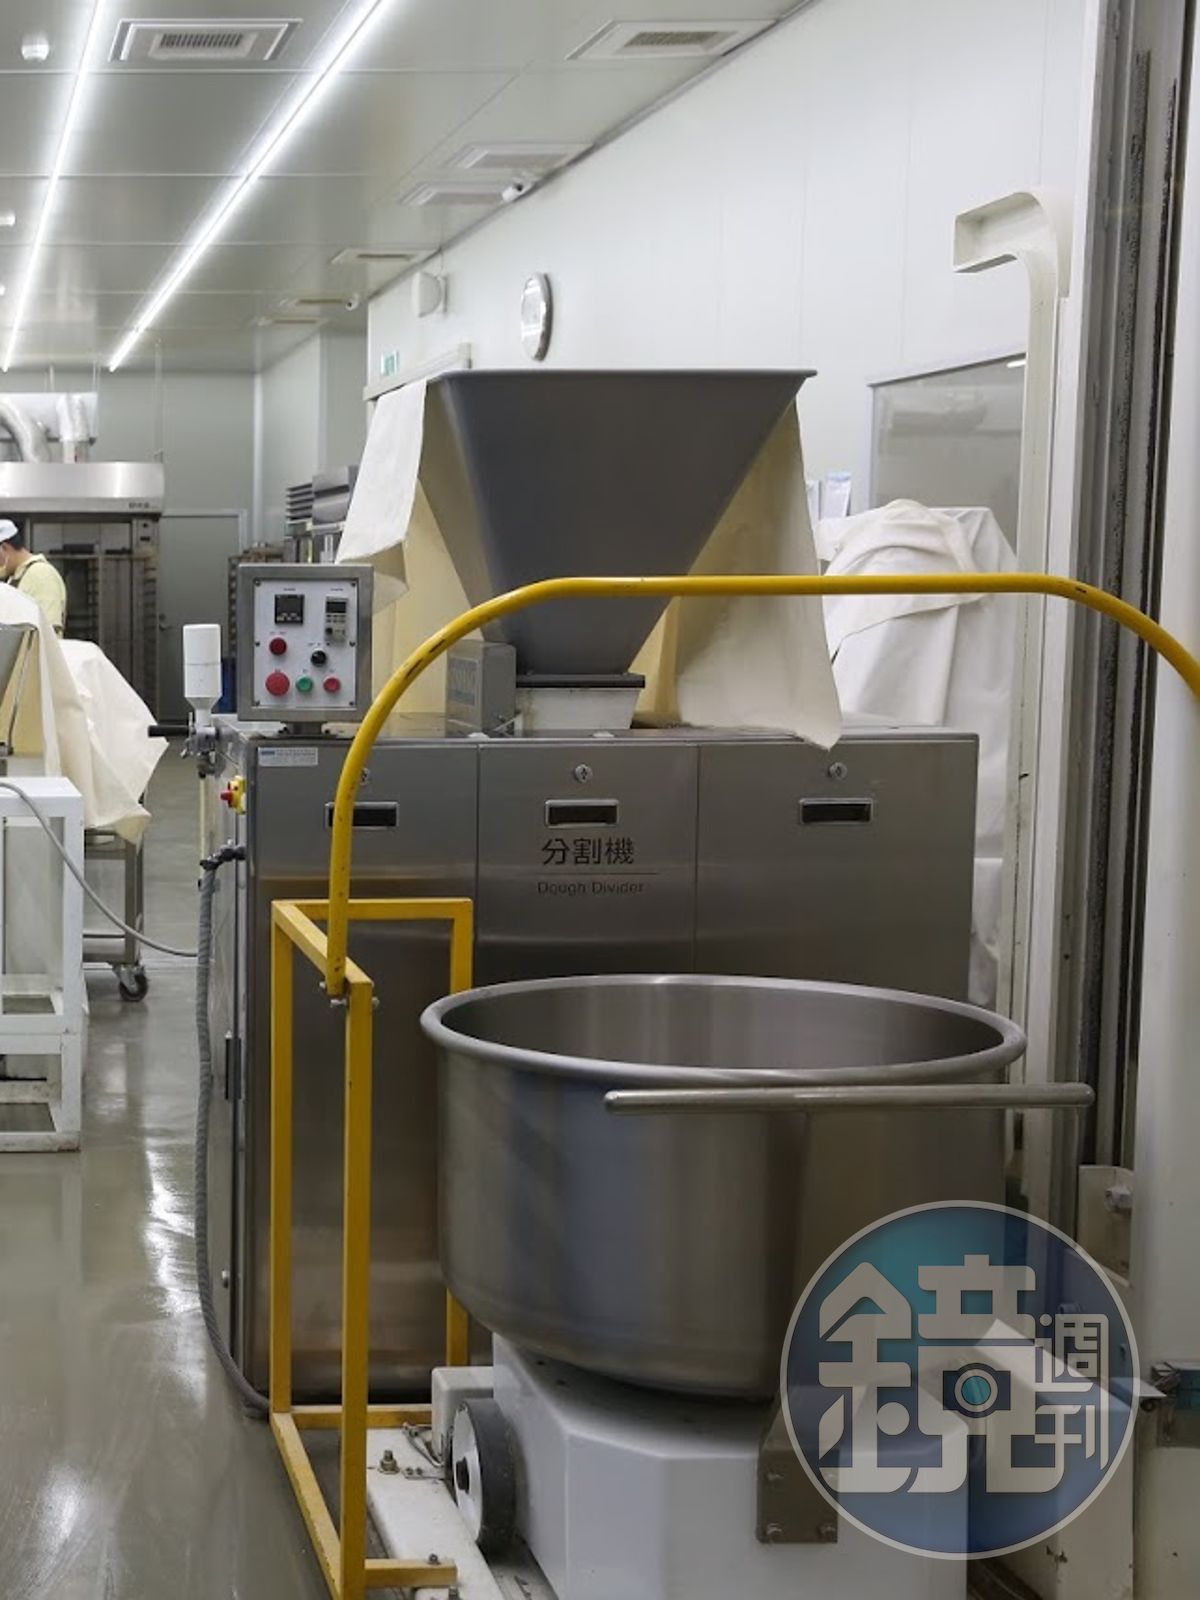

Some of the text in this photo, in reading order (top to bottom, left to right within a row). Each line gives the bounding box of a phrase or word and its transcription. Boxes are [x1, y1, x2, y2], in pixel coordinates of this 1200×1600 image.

[541, 837, 635, 866] 分割機
[537, 881, 645, 896] Dough Divider
